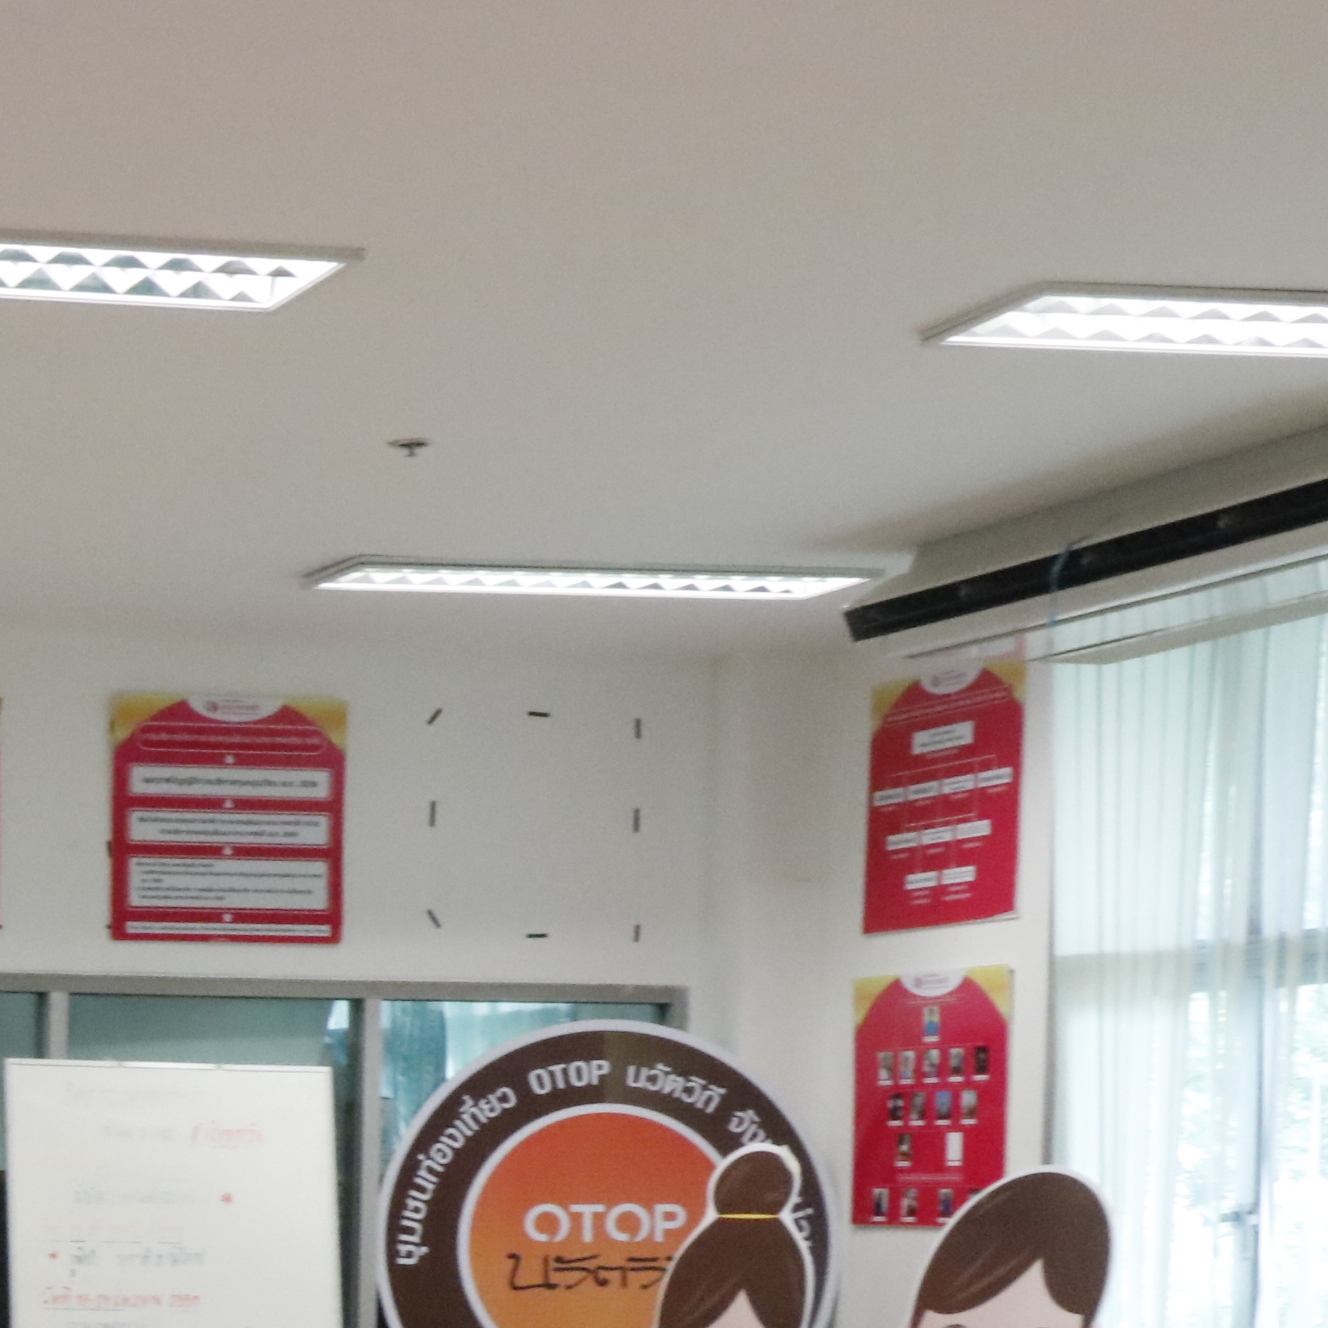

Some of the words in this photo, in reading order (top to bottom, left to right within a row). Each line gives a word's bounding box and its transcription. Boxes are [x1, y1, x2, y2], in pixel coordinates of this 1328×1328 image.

[395, 1086, 518, 1266] ชุมชนท่องเที่ยว
[527, 1059, 612, 1095] OTOP
[625, 1062, 727, 1114] นวัตวิถี
[523, 1203, 688, 1242] OTOP
